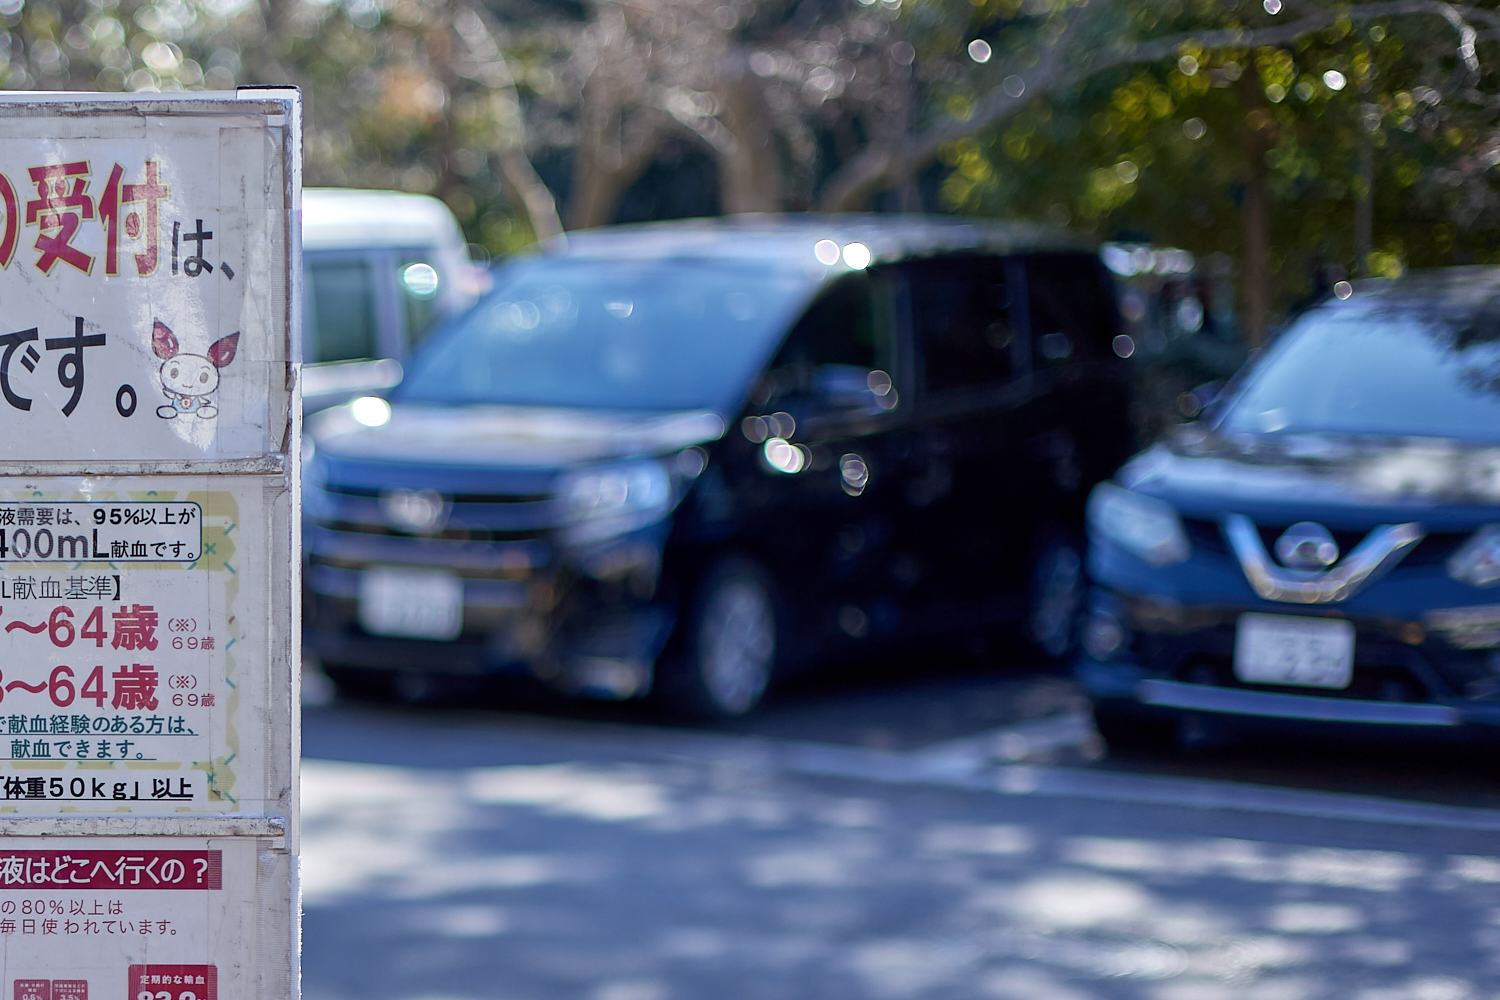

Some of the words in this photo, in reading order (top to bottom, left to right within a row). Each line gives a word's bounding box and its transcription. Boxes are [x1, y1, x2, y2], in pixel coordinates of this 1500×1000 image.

[171, 636, 216, 651] 69歳
[171, 693, 216, 707] 69歳
[139, 975, 206, 985] 定期的な輸血
